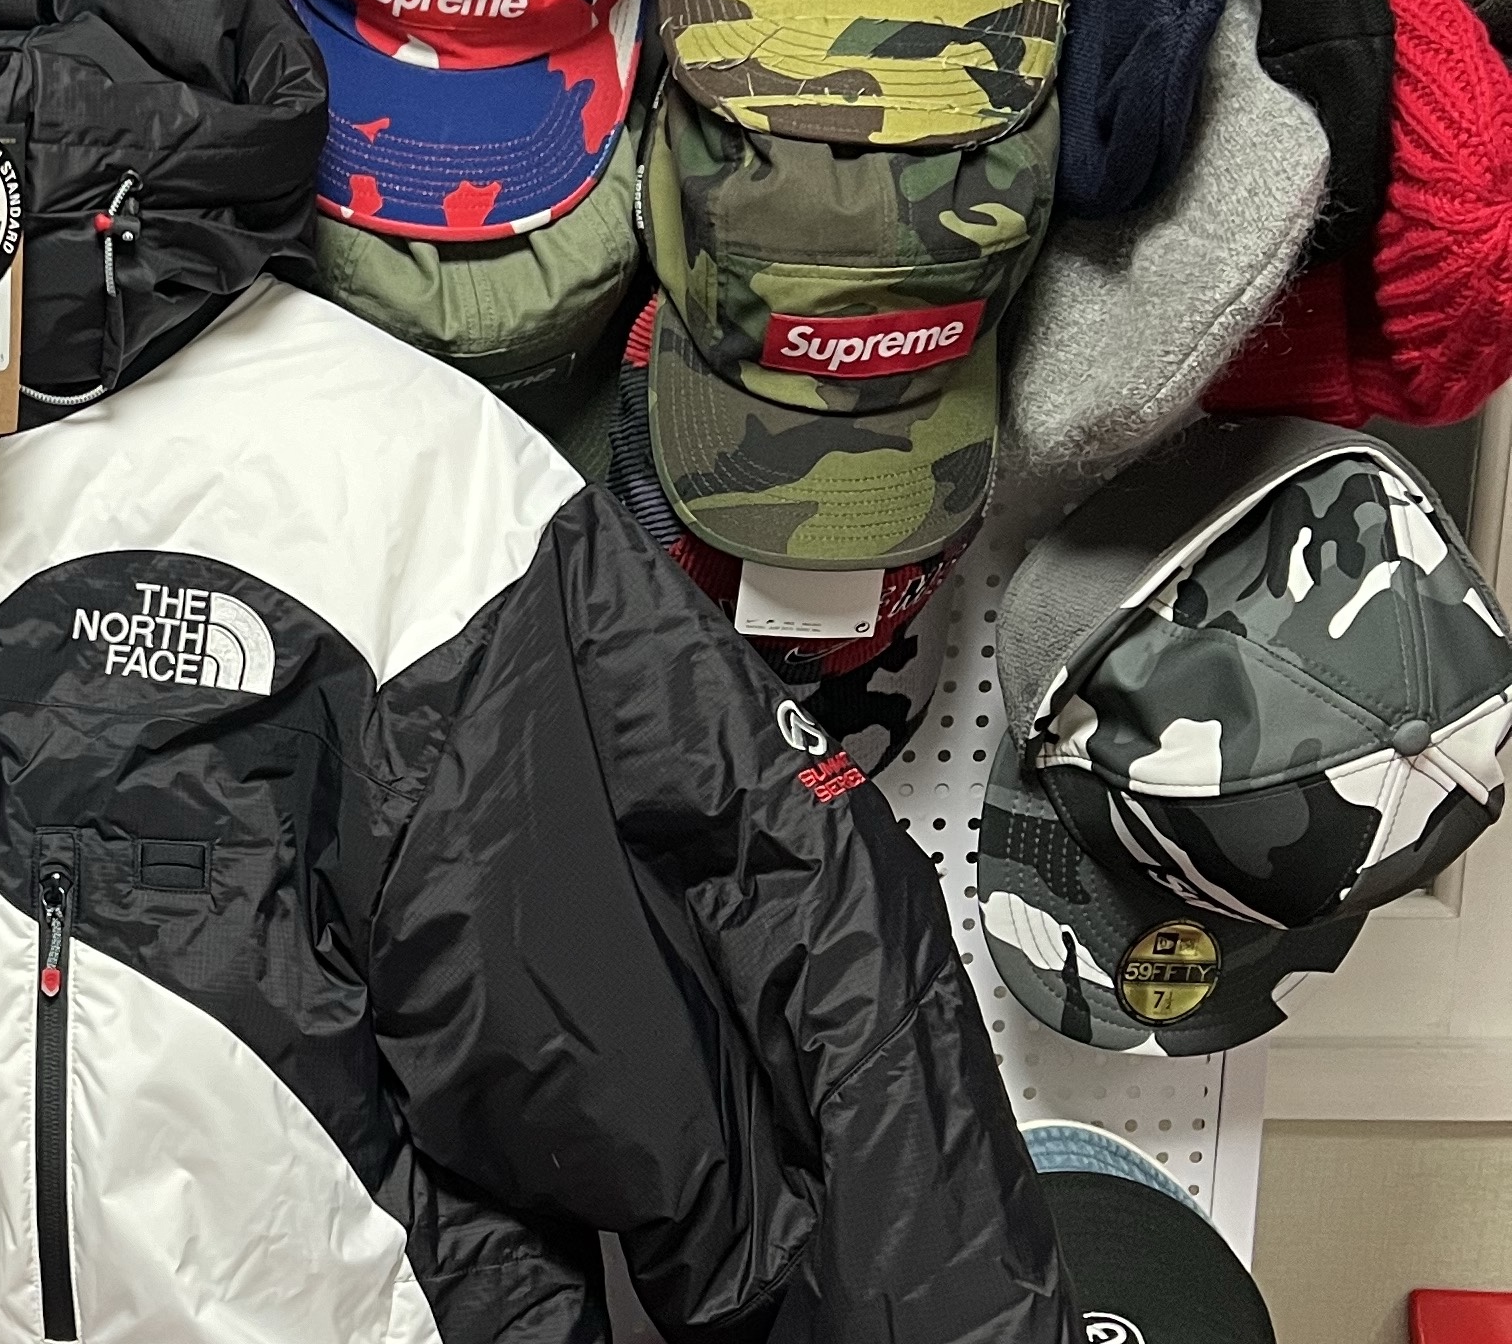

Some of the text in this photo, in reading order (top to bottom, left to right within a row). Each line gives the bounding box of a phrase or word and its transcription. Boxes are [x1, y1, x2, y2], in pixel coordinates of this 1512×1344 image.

[0, 160, 22, 255] STANDARD
[780, 317, 965, 371] Supreme
[135, 582, 209, 622] THE
[72, 608, 205, 655] NORTH
[104, 644, 202, 685] FACE
